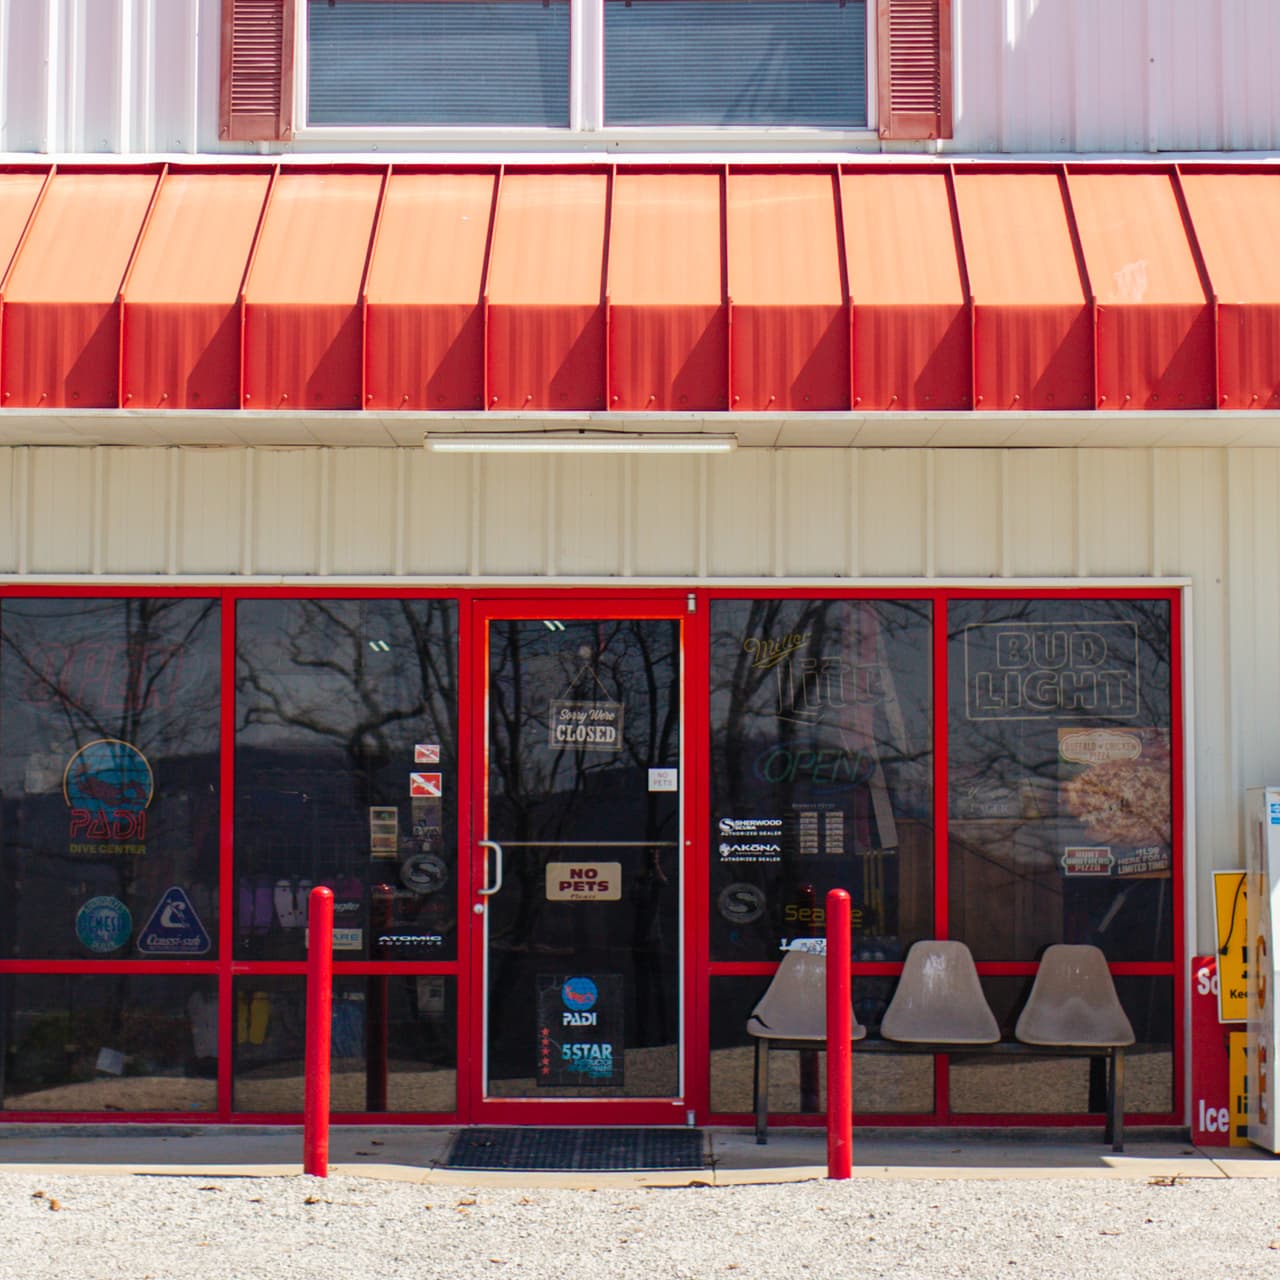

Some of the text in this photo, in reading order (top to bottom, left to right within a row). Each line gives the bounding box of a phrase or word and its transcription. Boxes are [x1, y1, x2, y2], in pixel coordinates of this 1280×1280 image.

[996, 630, 1109, 670] BUD
[975, 669, 1132, 710] LIGHT
[559, 708, 588, 724] Sorry
[556, 724, 617, 743] CLOSED
[763, 748, 864, 784] OPEN
[657, 771, 669, 779] NO
[652, 779, 673, 788] PETS
[70, 808, 148, 842] PADI
[71, 843, 147, 855] DIVE CENTER
[569, 867, 599, 880] NO
[558, 880, 610, 893] PETS
[378, 934, 443, 942] ATOMIC
[562, 1012, 598, 1027] PADI
[1198, 1099, 1230, 1133] Ice
